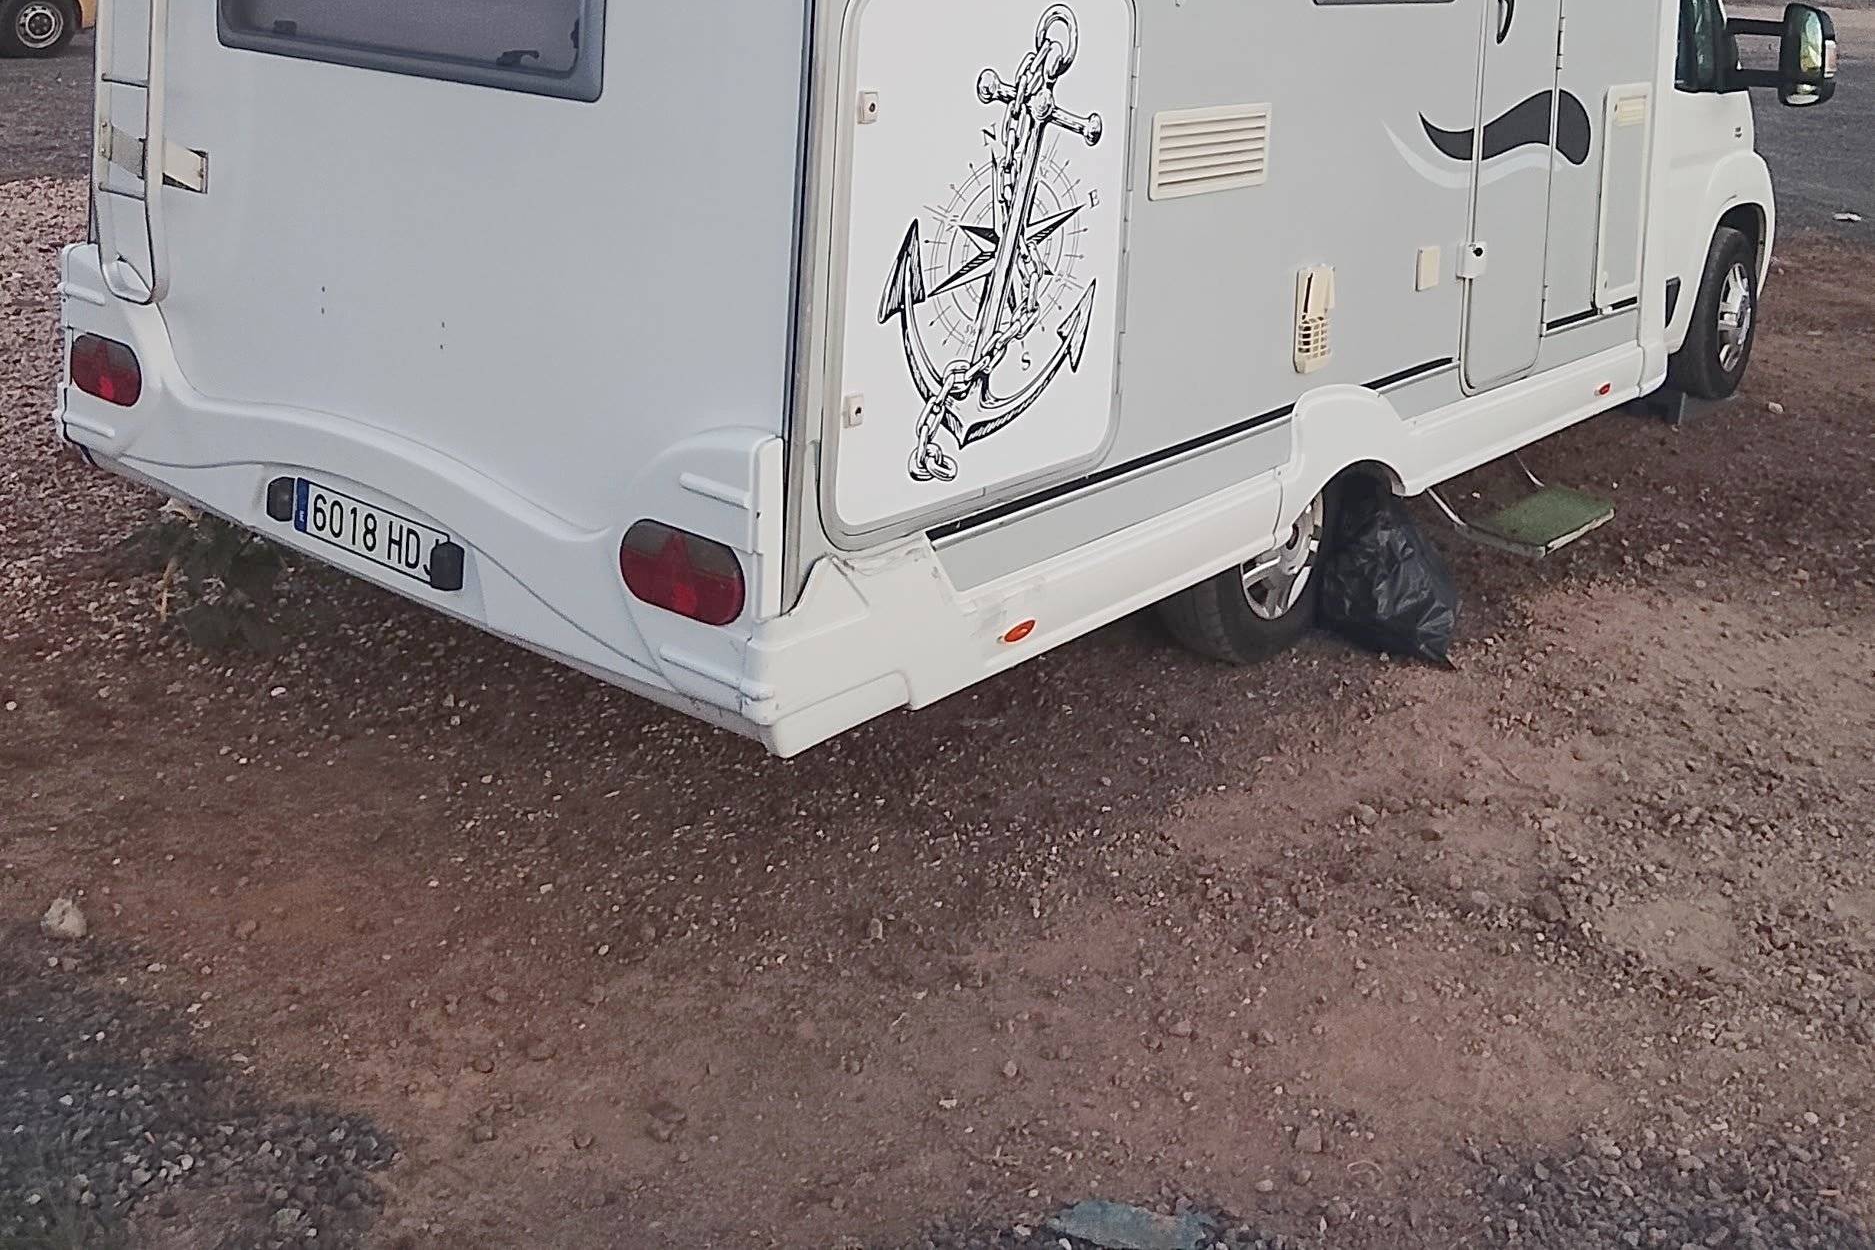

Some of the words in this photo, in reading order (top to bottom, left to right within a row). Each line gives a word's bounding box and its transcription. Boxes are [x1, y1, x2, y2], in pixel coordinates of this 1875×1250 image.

[982, 123, 997, 146] N
[1087, 189, 1100, 209] E
[1021, 352, 1031, 371] S
[313, 494, 377, 553] 6018
